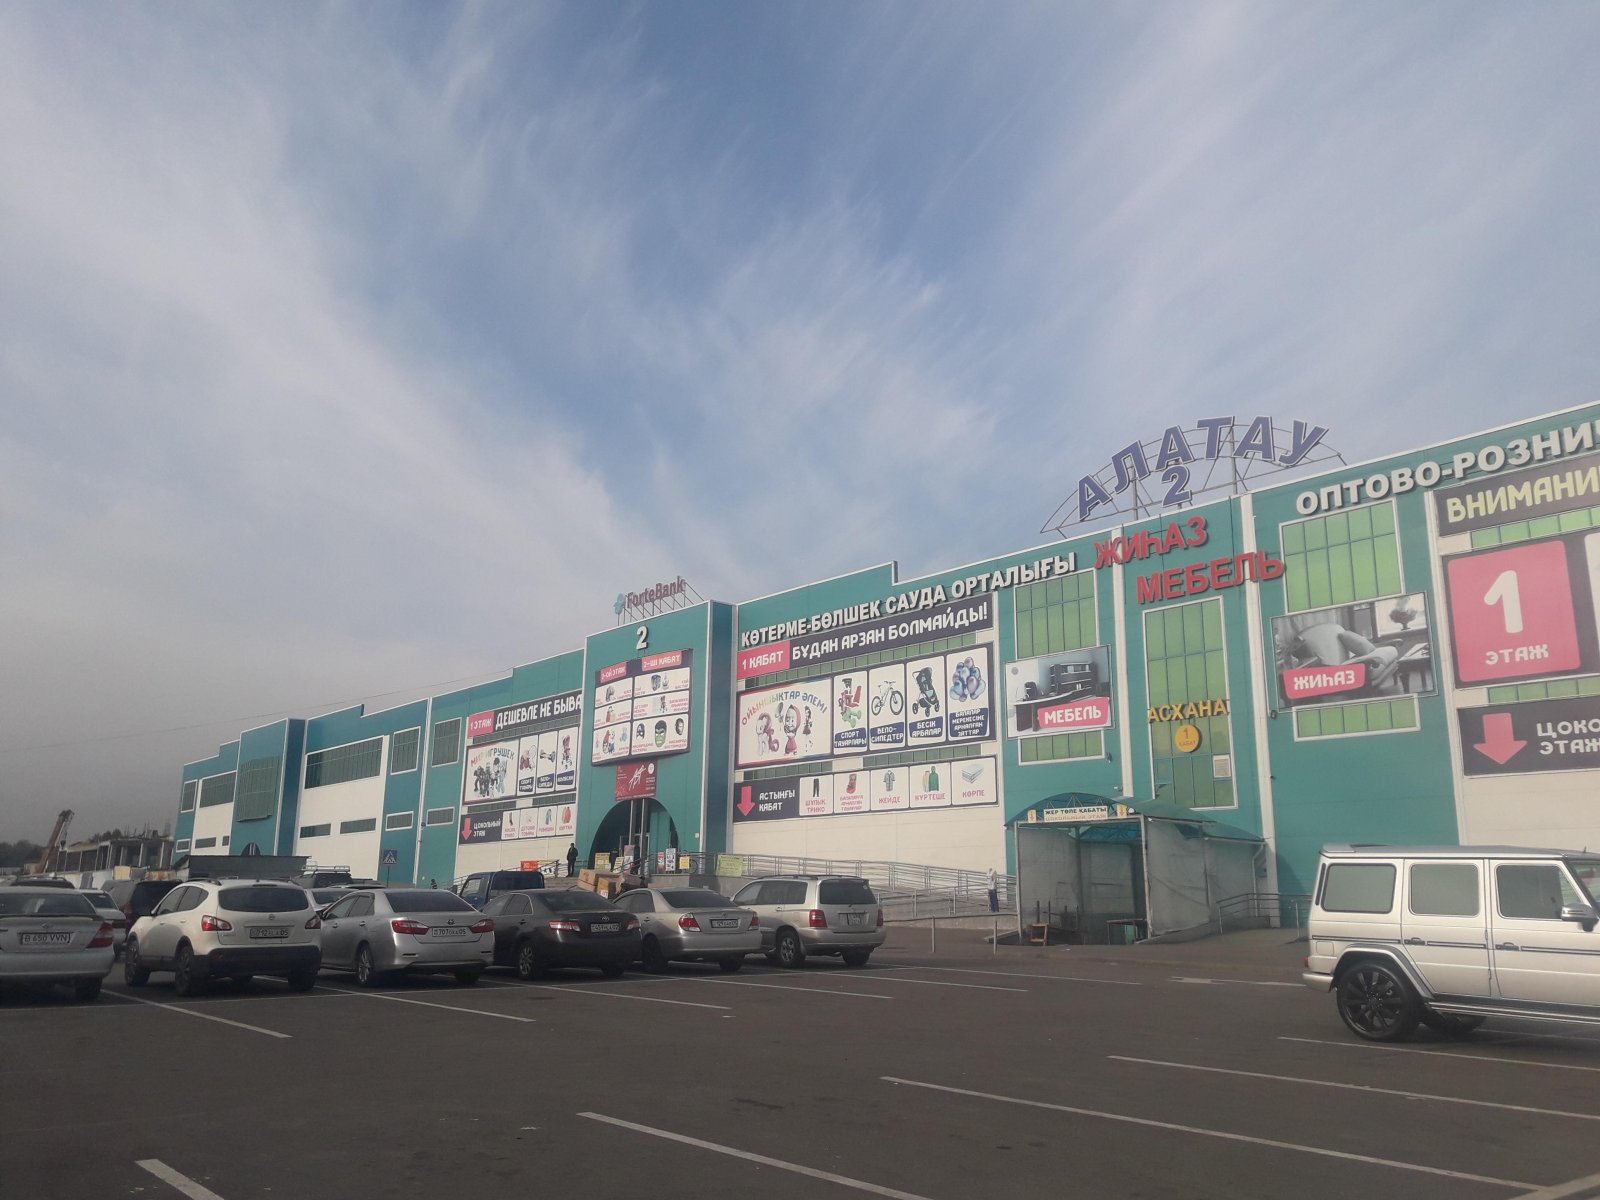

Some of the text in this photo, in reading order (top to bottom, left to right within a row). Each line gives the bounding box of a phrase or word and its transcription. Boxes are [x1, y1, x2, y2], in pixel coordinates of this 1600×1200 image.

[1077, 415, 1329, 520] АЛАТАУ
[1161, 465, 1192, 508] 2
[1446, 465, 1600, 523] ВНИМАНИ
[1094, 516, 1208, 569] ЖИҺАЗ
[627, 575, 687, 609] ForteBank
[1136, 550, 1285, 605] МЕБЕЛЬ
[741, 551, 1076, 647] КӨТЕРМЕ-БӨЛШЕК САУДА ОРТАЛЫҒЫ
[1484, 570, 1524, 634] 1
[636, 625, 648, 650] 2
[741, 659, 747, 670] 1
[841, 626, 885, 650] АРЗАН
[888, 602, 988, 642] БОЛМАЙДЫ!
[1485, 644, 1550, 666] ЭТАЖ
[1293, 669, 1356, 691] ЖИҺАЗ
[474, 717, 493, 729] ЭТАЖ
[495, 704, 539, 731] ДЕШЕВЛЕ
[540, 701, 552, 718] НЕ
[1044, 705, 1102, 725] МЕБЕЛЬ
[1148, 696, 1229, 723] АСХАНА
[840, 731, 860, 739] СПОРТ
[871, 732, 904, 743] СИПЕДТЕР
[1536, 718, 1600, 739] ЦОКО
